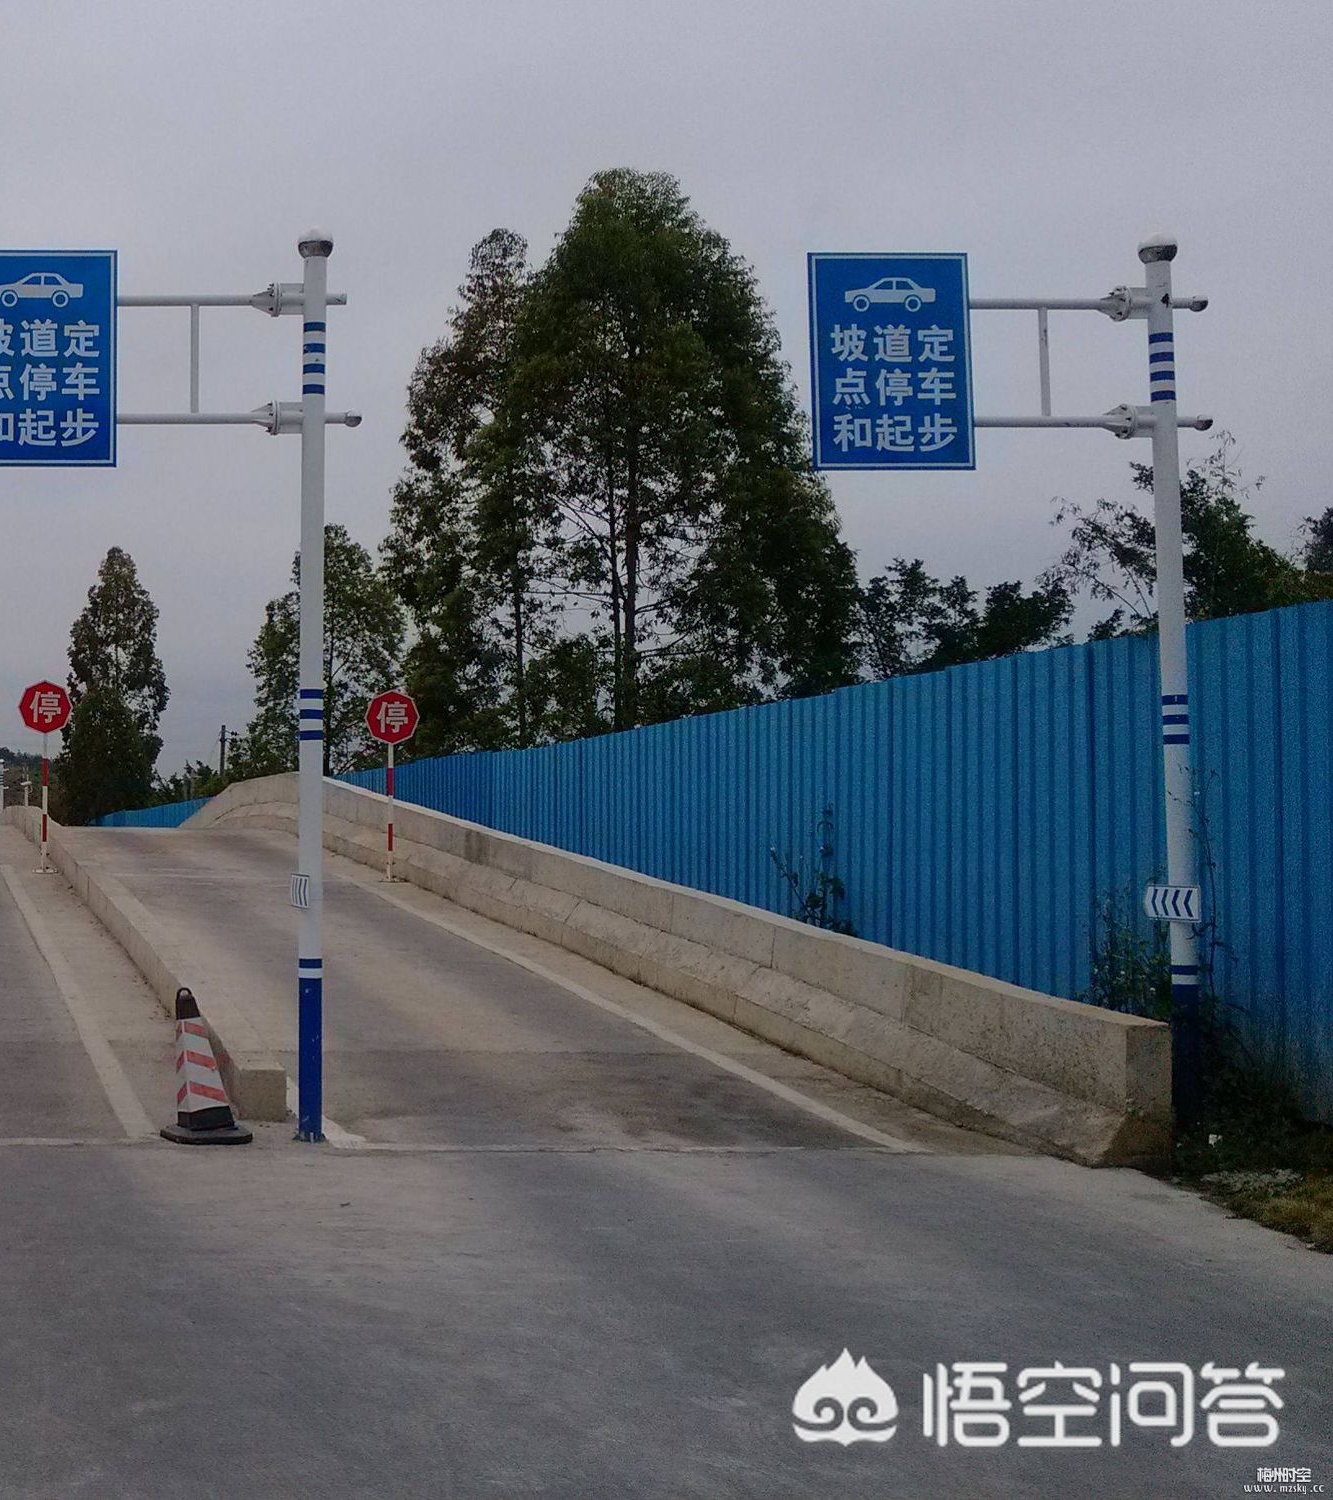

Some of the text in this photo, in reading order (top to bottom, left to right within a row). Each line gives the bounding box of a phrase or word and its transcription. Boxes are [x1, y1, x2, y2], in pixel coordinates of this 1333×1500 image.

[830, 324, 955, 362] 坡道定
[832, 367, 957, 406] 点停车
[833, 412, 957, 452] 和起步
[29, 691, 61, 723] 停
[376, 701, 408, 733] 停
